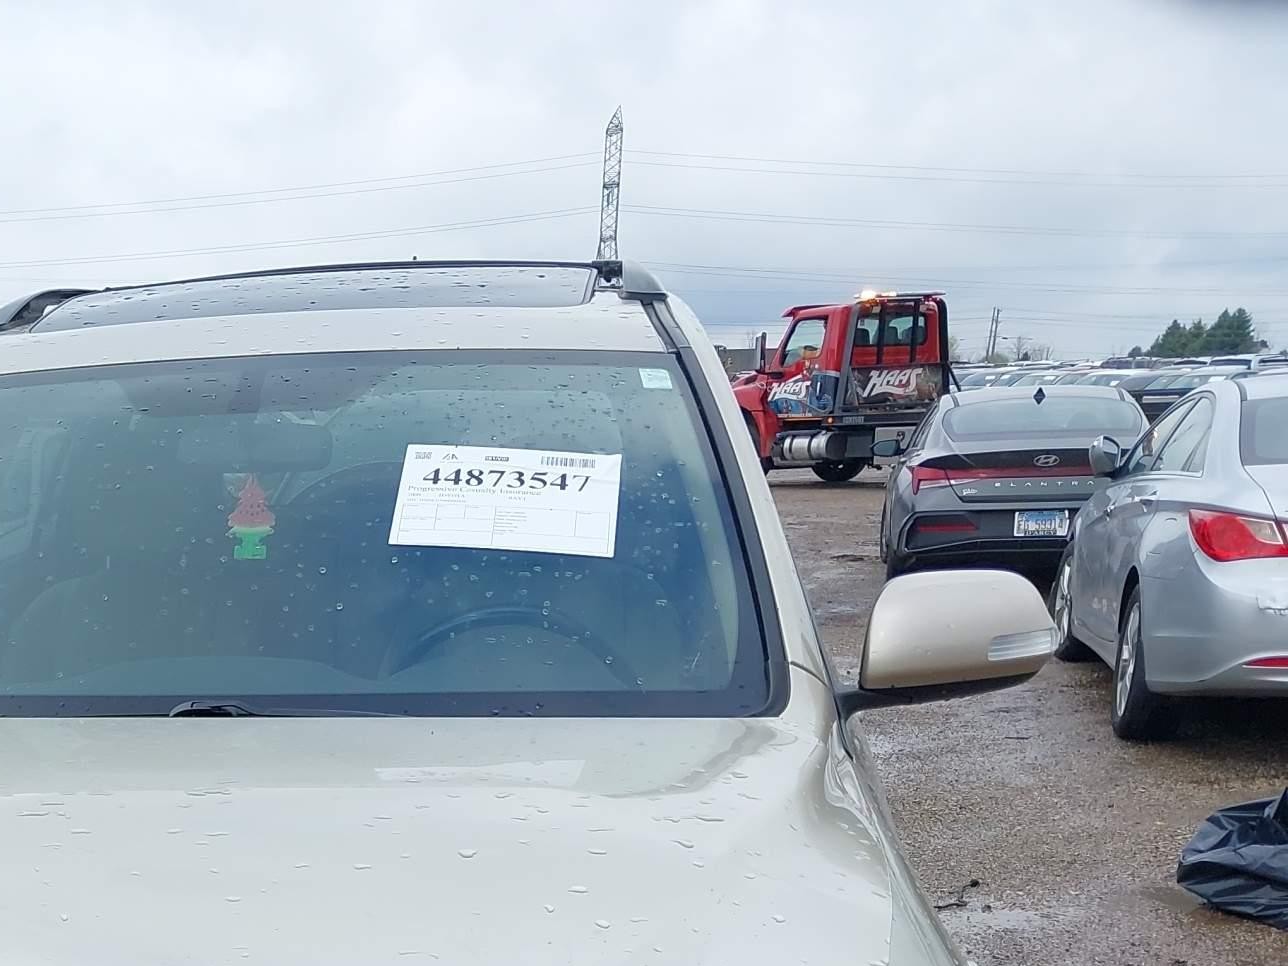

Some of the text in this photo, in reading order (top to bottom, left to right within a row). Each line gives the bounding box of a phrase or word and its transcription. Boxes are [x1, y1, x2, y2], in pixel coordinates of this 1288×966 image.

[767, 380, 812, 402] HAAS
[862, 367, 924, 398] HAAS
[422, 467, 592, 493] 44873547
[994, 480, 1095, 488] ELANTRA
